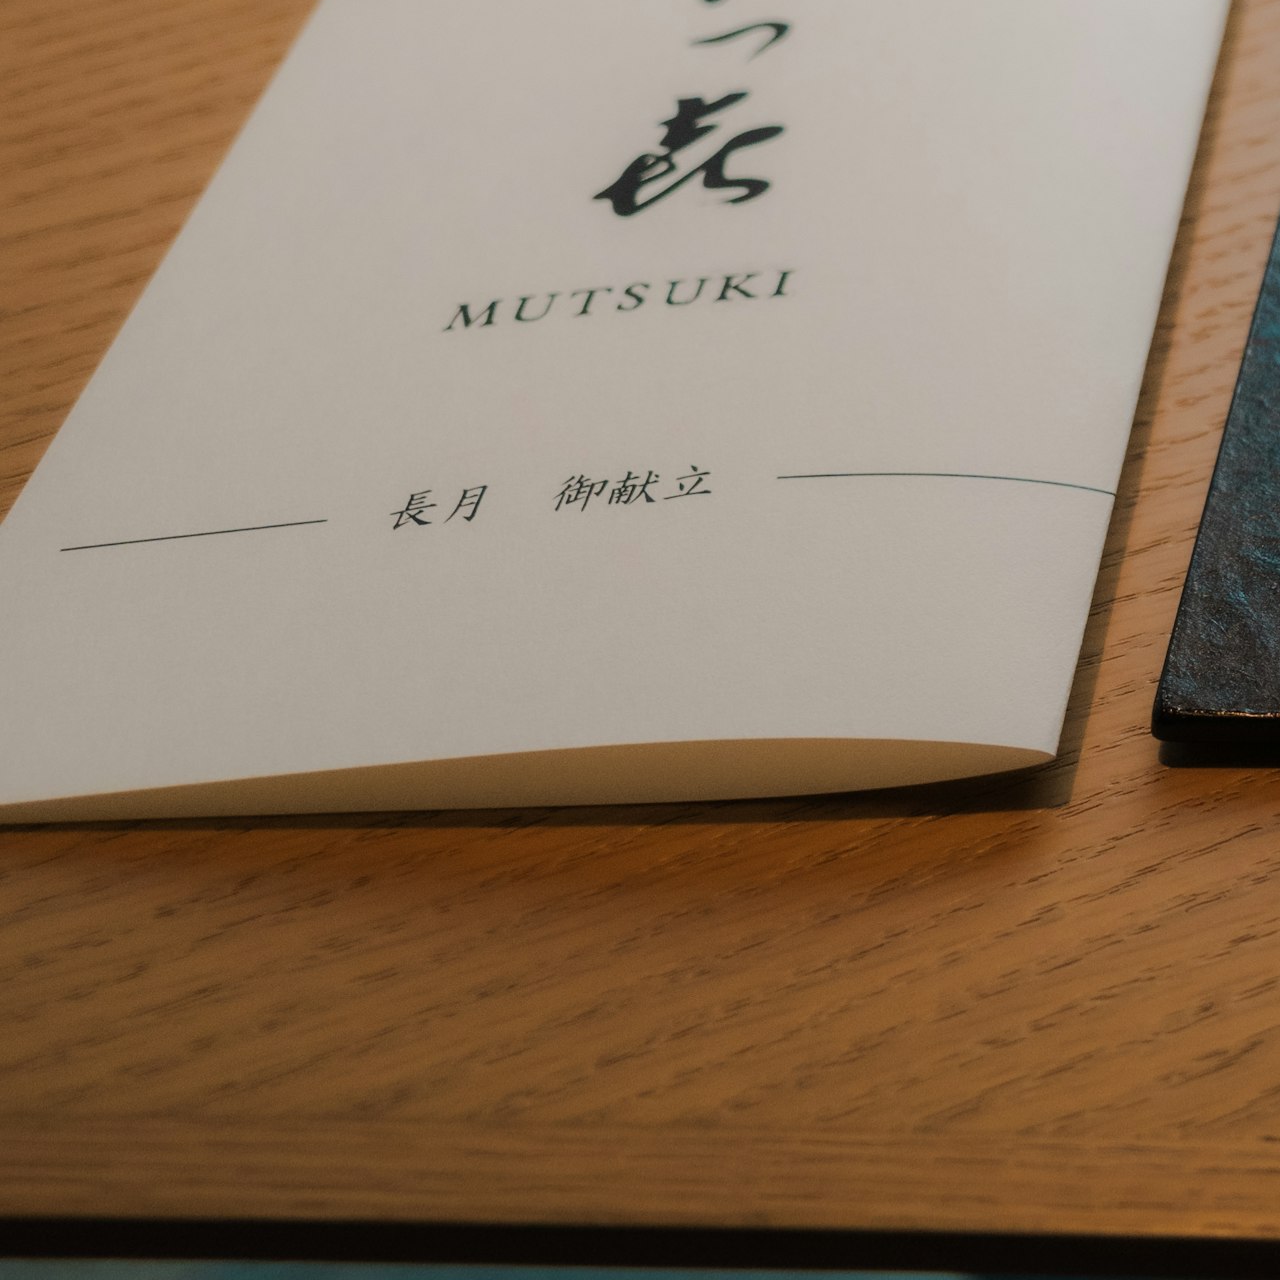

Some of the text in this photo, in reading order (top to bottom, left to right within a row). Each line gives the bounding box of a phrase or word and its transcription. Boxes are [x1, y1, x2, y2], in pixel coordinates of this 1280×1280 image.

[442, 269, 795, 333] MUTSUKI
[388, 464, 713, 531] 長月 御献立
